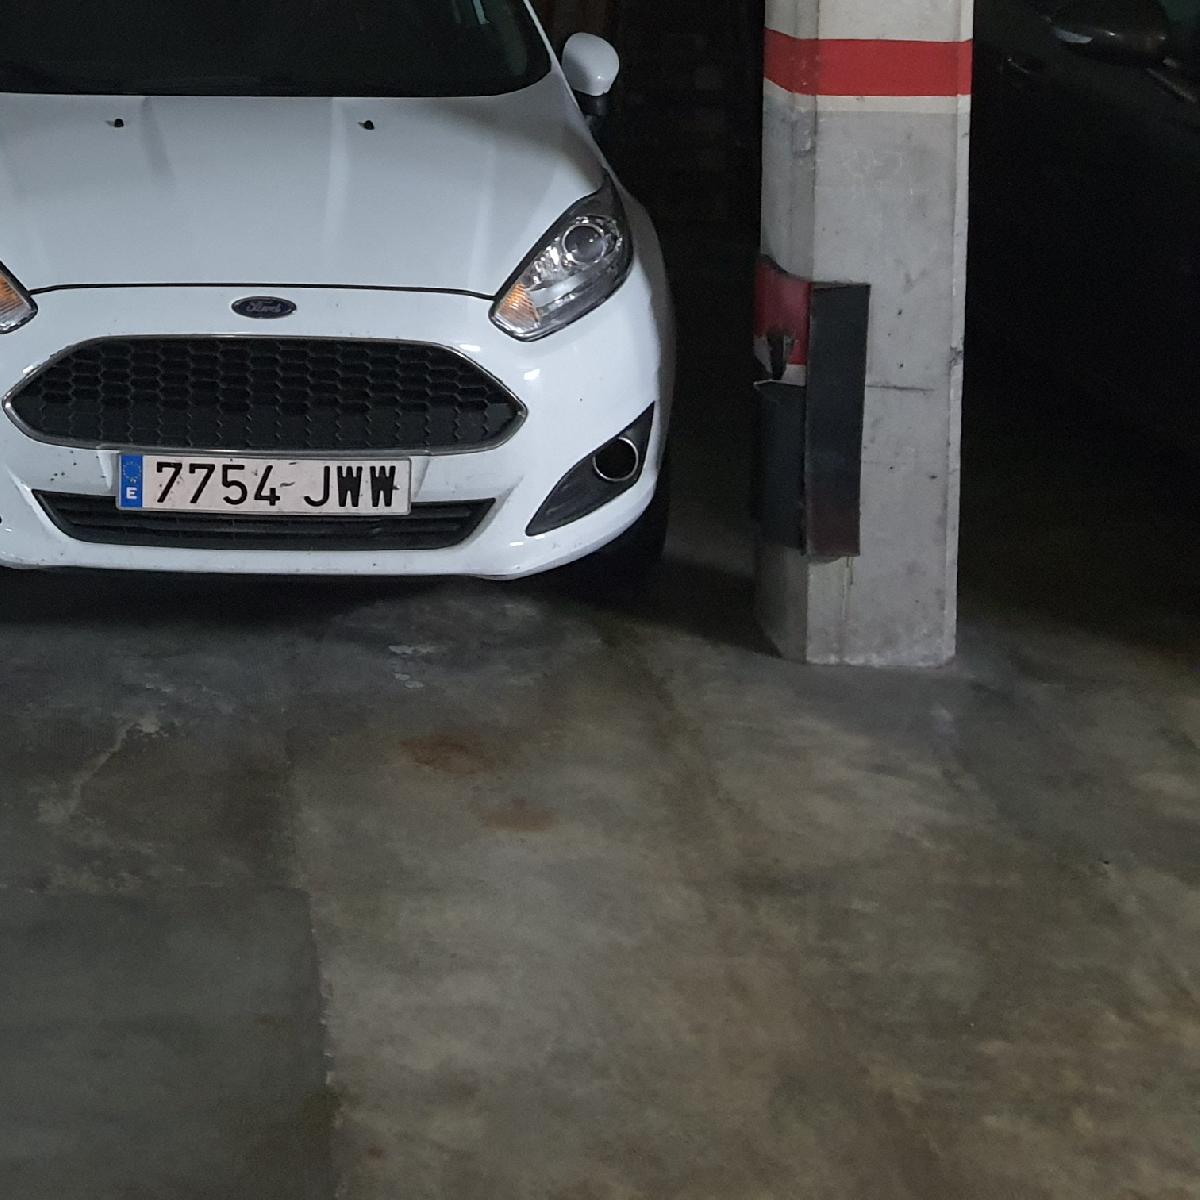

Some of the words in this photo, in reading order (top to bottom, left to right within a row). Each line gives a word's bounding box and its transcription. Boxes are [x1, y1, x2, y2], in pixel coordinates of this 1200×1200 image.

[245, 301, 282, 312] Ford
[156, 462, 280, 506] 7754
[303, 465, 396, 508] JWW
[126, 488, 138, 499] E
